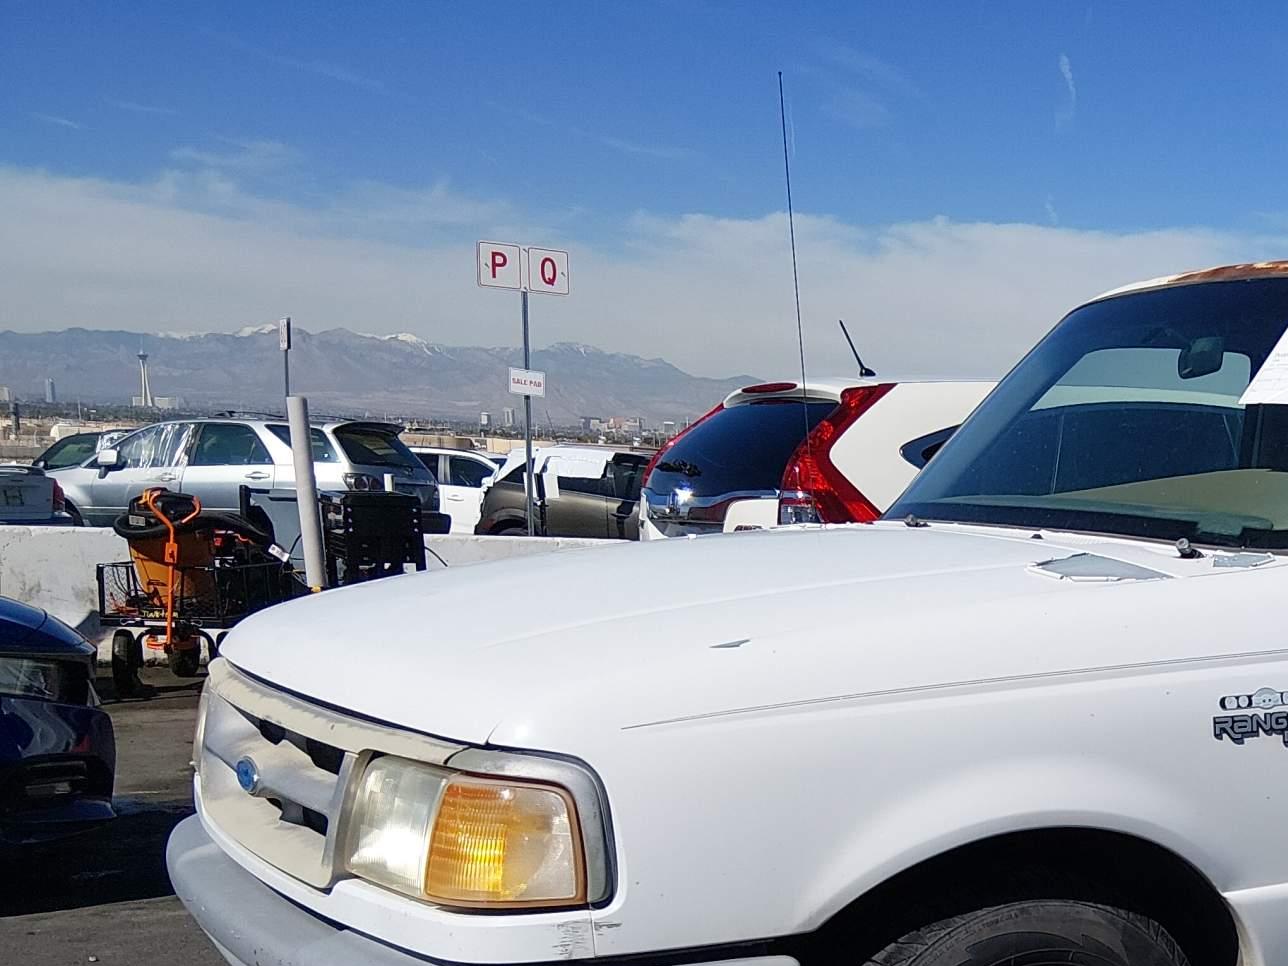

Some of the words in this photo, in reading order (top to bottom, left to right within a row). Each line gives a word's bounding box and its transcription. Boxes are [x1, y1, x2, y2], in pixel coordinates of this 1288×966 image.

[490, 251, 508, 279] P
[540, 256, 557, 286] Q
[512, 377, 528, 386] SALE
